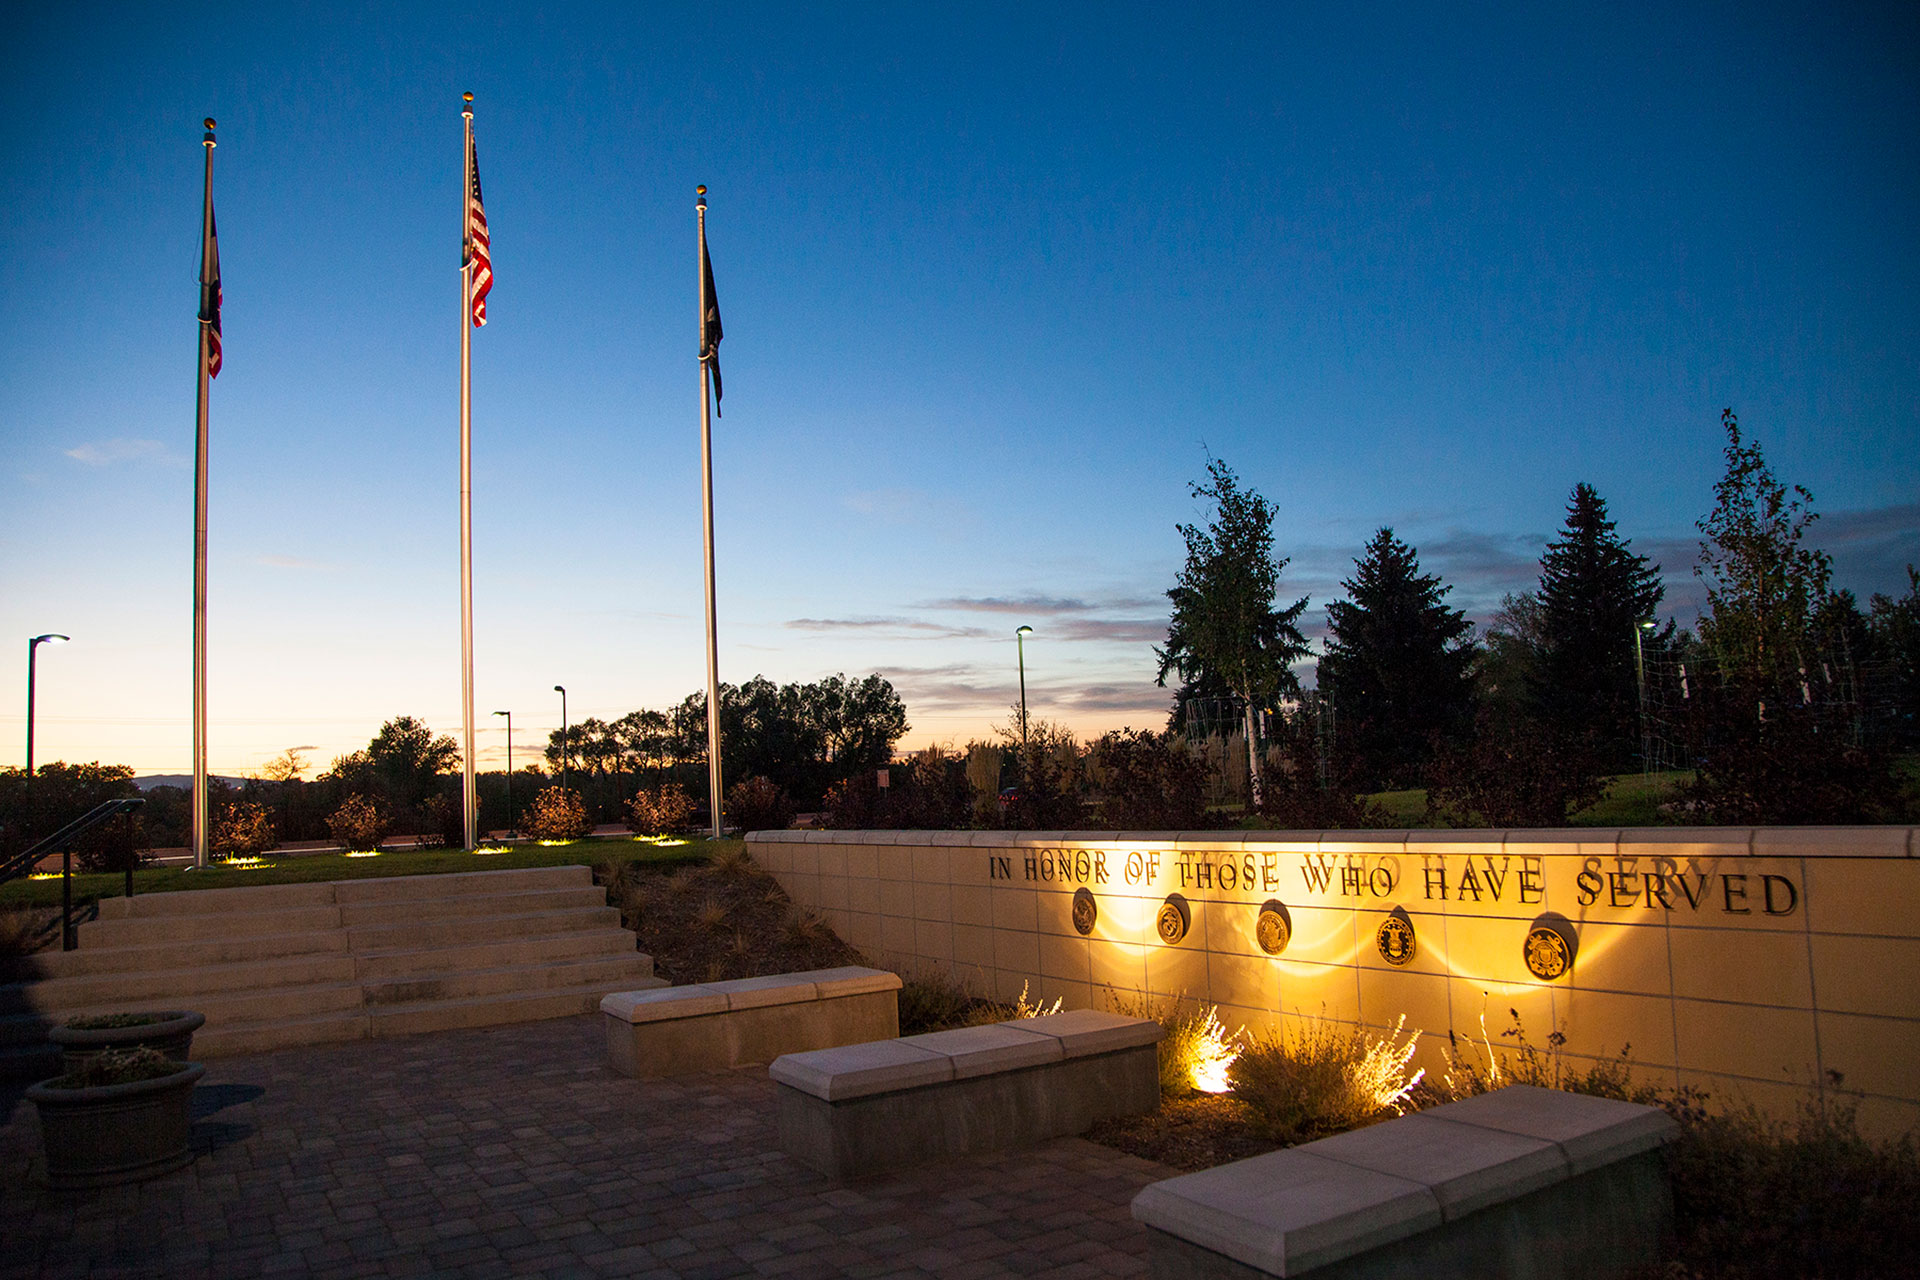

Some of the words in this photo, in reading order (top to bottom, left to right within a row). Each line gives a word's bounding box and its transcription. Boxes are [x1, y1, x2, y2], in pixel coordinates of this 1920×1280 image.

[990, 857, 1012, 880] IN
[1024, 857, 1109, 885] HONOR
[1125, 861, 1157, 886] OF
[1175, 862, 1279, 892] THOSE
[1301, 865, 1393, 897] WHO
[1422, 869, 1542, 904] HAVE
[1576, 871, 1798, 915] SERVED
